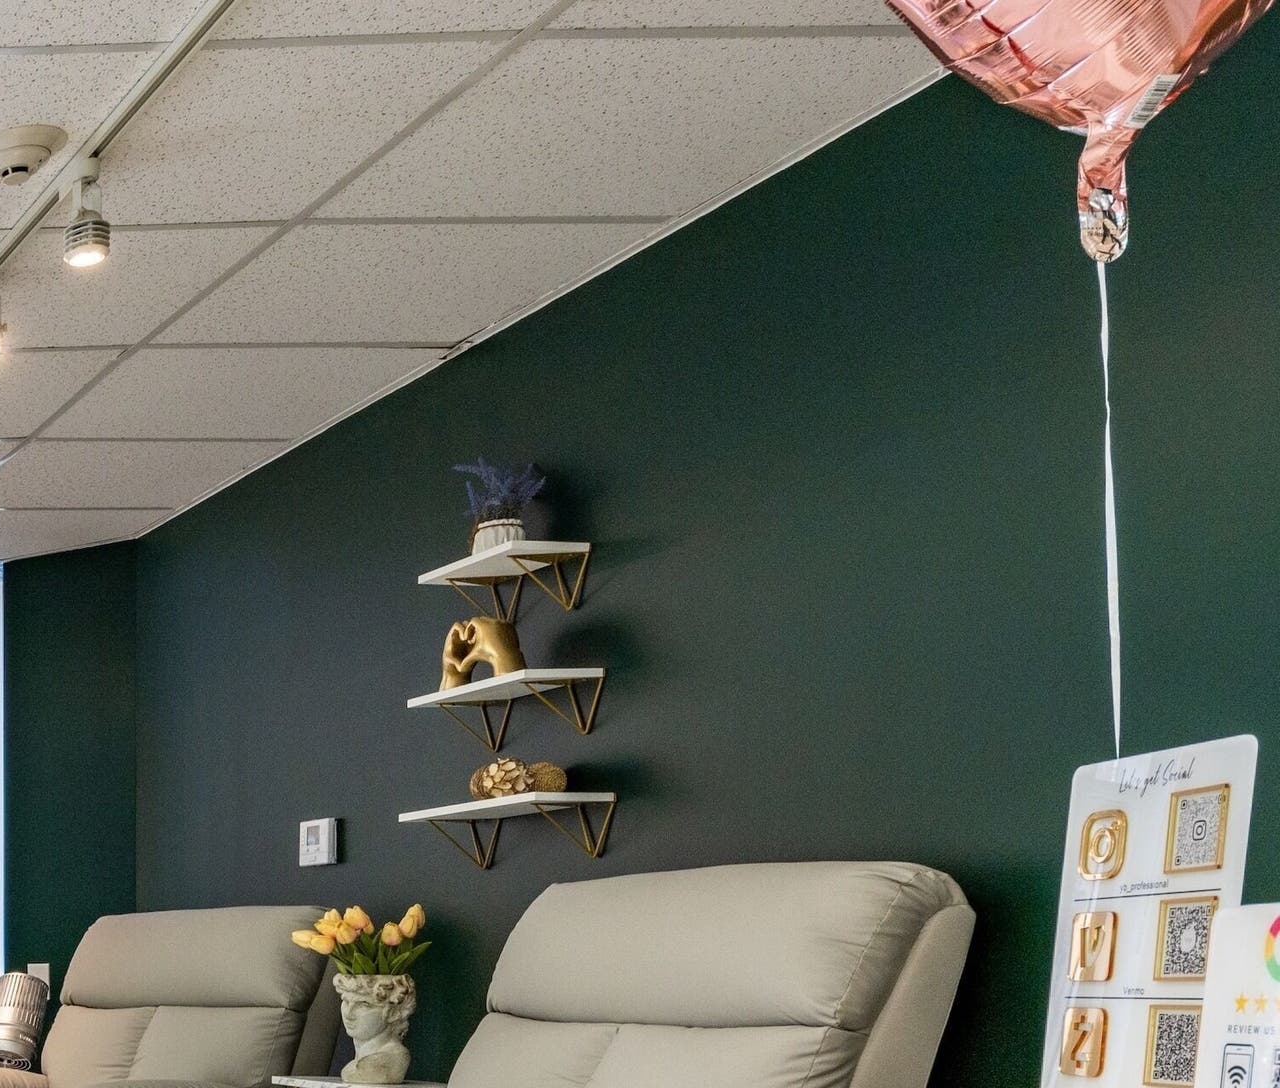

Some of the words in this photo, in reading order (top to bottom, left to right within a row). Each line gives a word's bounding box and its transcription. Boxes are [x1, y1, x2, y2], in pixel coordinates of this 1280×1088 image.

[1140, 763, 1161, 798] get
[1162, 757, 1196, 786] Social
[1123, 985, 1145, 996] Venmo
[1227, 1024, 1261, 1035] REVIEW
